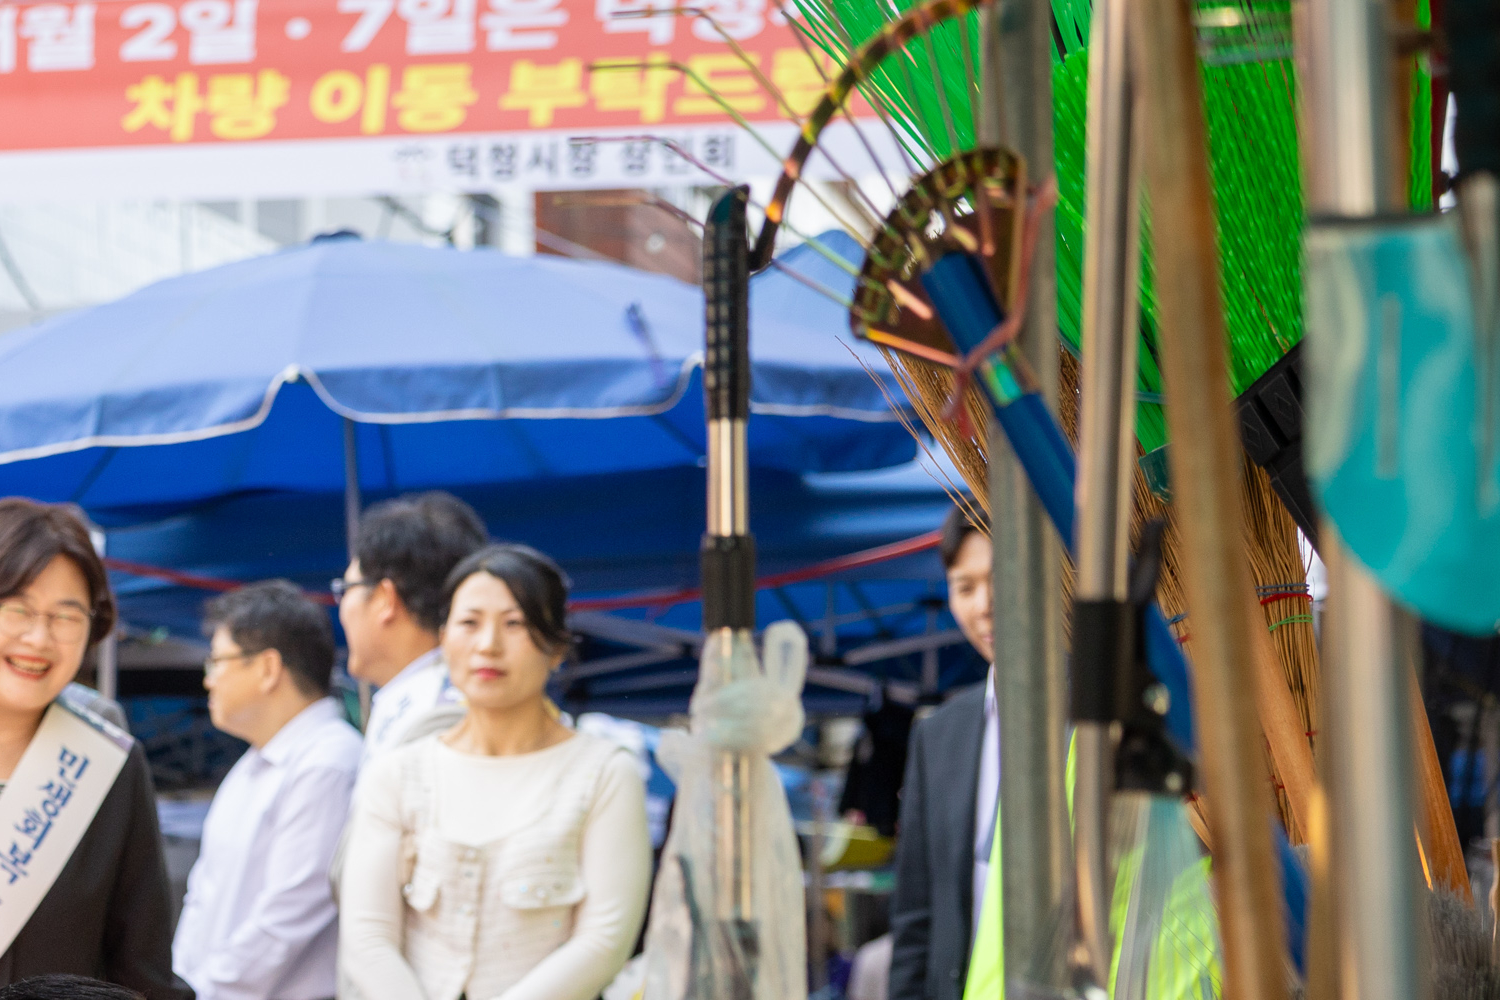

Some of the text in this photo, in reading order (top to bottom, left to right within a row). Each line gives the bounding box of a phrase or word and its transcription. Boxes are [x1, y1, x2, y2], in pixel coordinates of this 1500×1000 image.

[118, 0, 258, 65] 2일
[337, 0, 570, 54] 7일은
[121, 68, 291, 142] 차량
[309, 62, 480, 135] 이동
